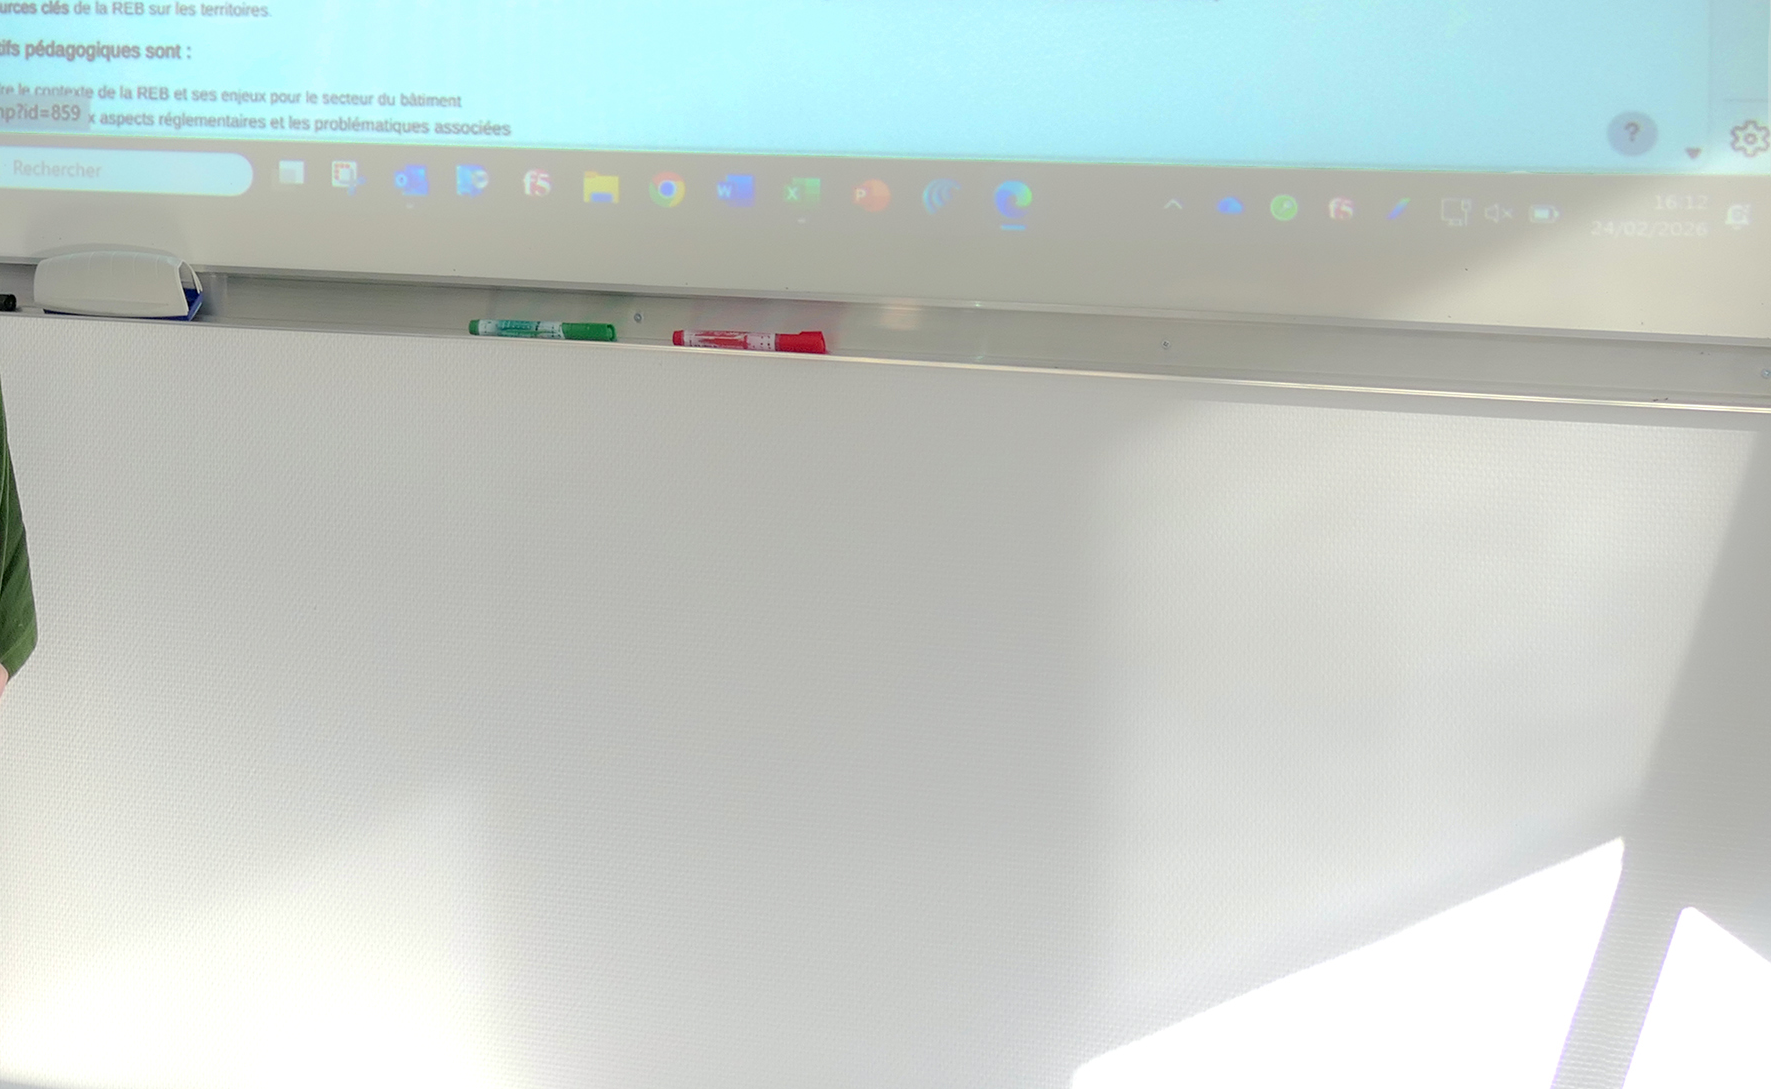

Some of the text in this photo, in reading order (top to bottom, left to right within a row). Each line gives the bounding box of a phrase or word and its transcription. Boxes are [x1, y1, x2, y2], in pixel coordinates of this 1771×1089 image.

[40, 0, 70, 16] clés
[73, 0, 92, 16] de
[95, 0, 108, 16] la
[111, 0, 145, 16] REB
[148, 4, 170, 17] sur
[174, 2, 196, 17] les
[199, 2, 273, 18] territoires.
[25, 39, 142, 63] pédagogiques
[145, 42, 182, 60] sont
[18, 83, 31, 96] le
[34, 84, 94, 99] contexte
[97, 85, 116, 100] de
[119, 85, 133, 100] la
[136, 86, 170, 101] REB
[173, 88, 188, 102] et
[191, 89, 217, 102] ses
[220, 89, 267, 105] enjeux
[269, 93, 302, 107] pour
[305, 90, 319, 105] le
[322, 91, 374, 106] secteur
[378, 91, 396, 106] du
[399, 92, 462, 108] bâtiment
[100, 112, 155, 129] aspects
[158, 112, 267, 130] réglementaires
[270, 117, 285, 130] et
[288, 115, 311, 130] les
[314, 115, 431, 135] problématiques
[434, 118, 512, 136] associées
[13, 159, 103, 179] Rechercher
